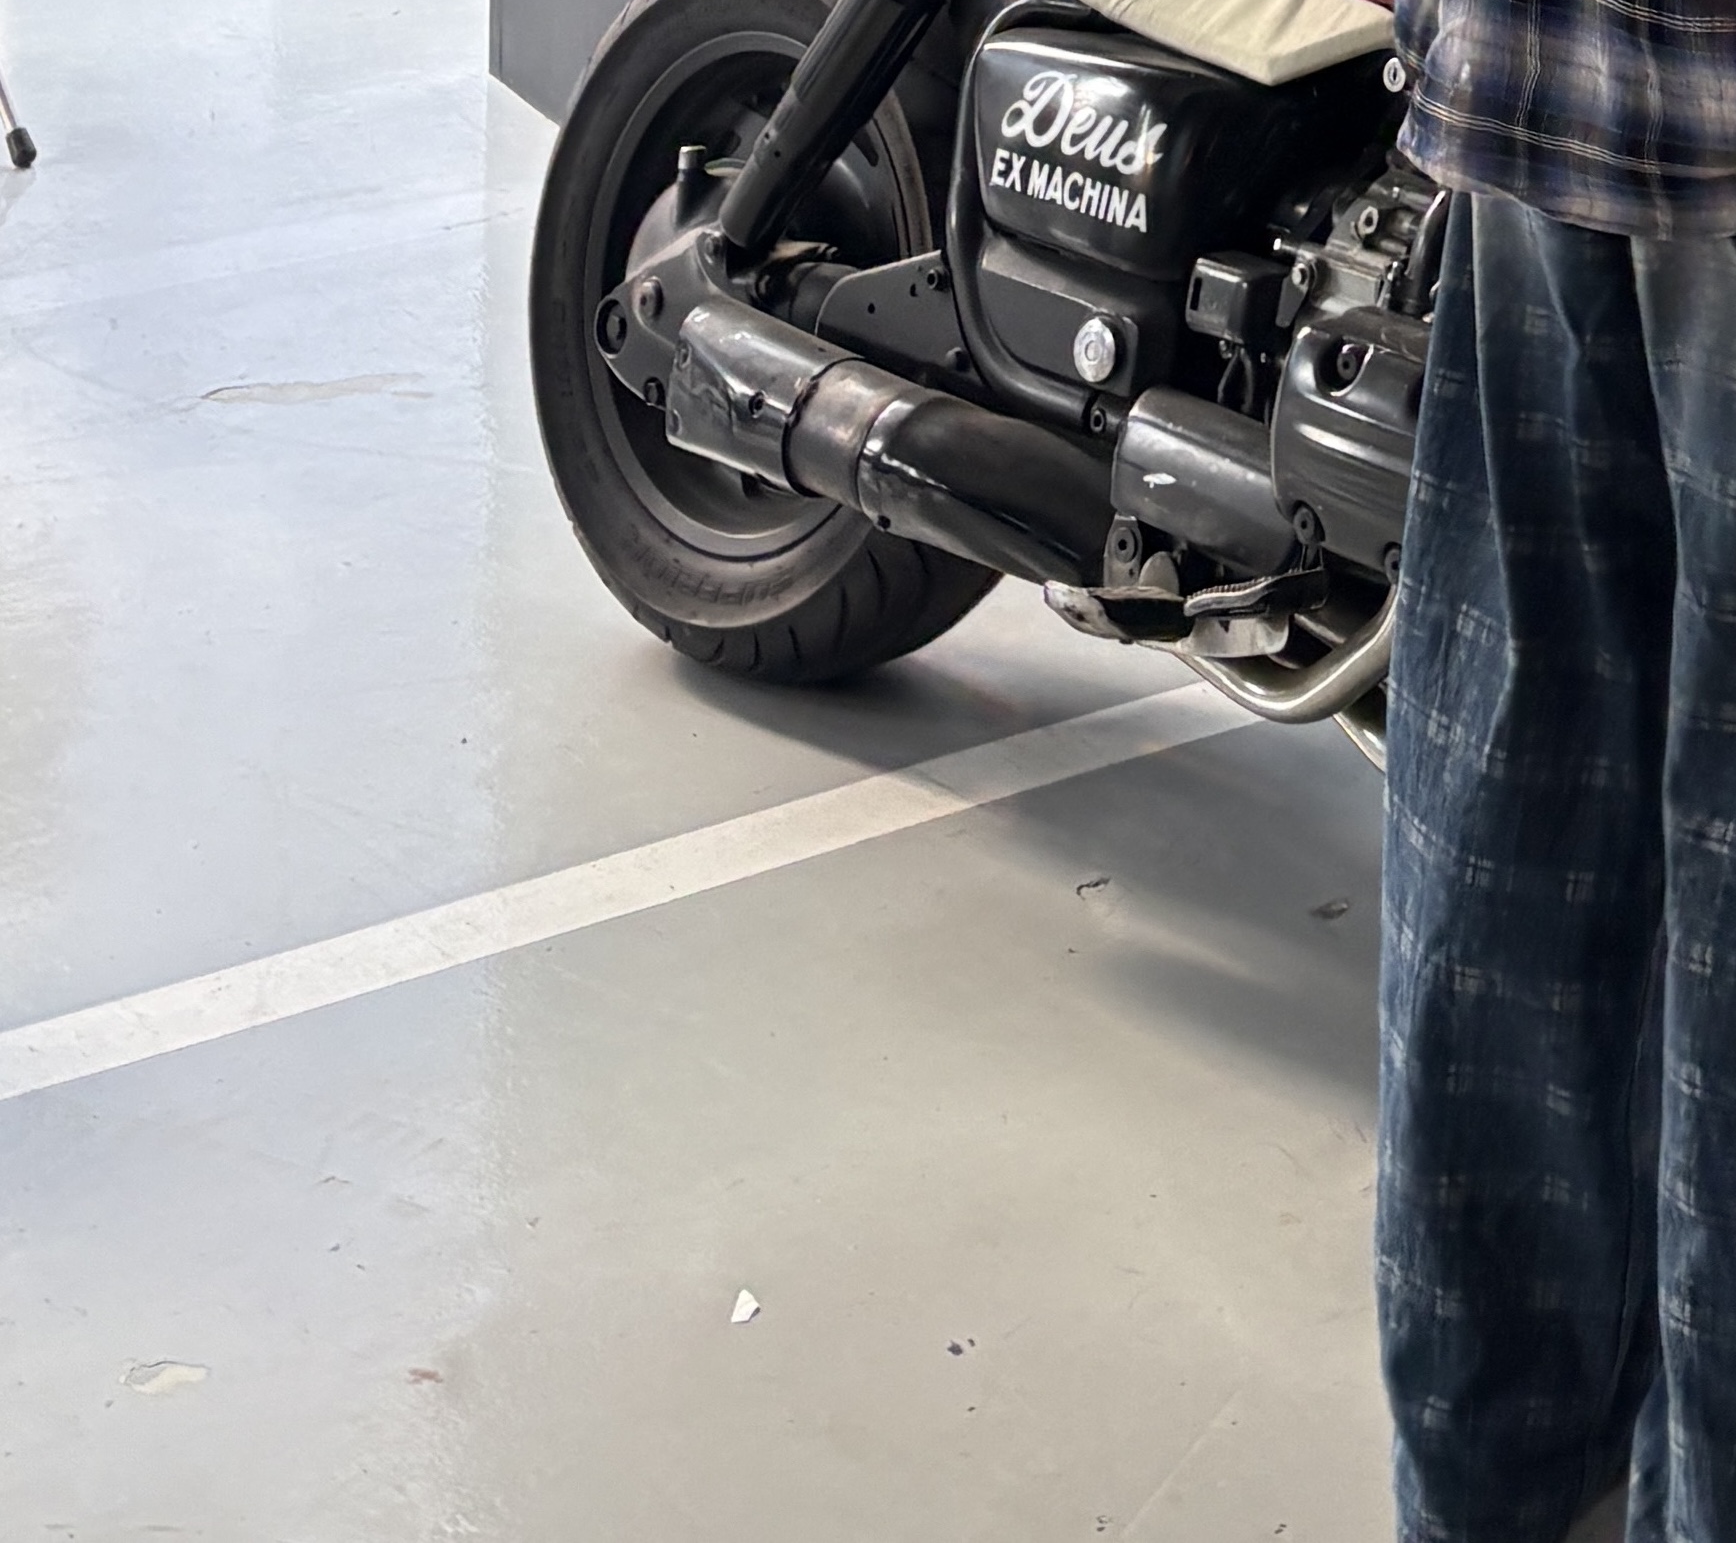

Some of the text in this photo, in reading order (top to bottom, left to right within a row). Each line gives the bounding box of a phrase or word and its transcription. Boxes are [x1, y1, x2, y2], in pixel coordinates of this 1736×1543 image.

[1001, 70, 1168, 176] Deus
[989, 147, 1148, 234] EX MACHINA
